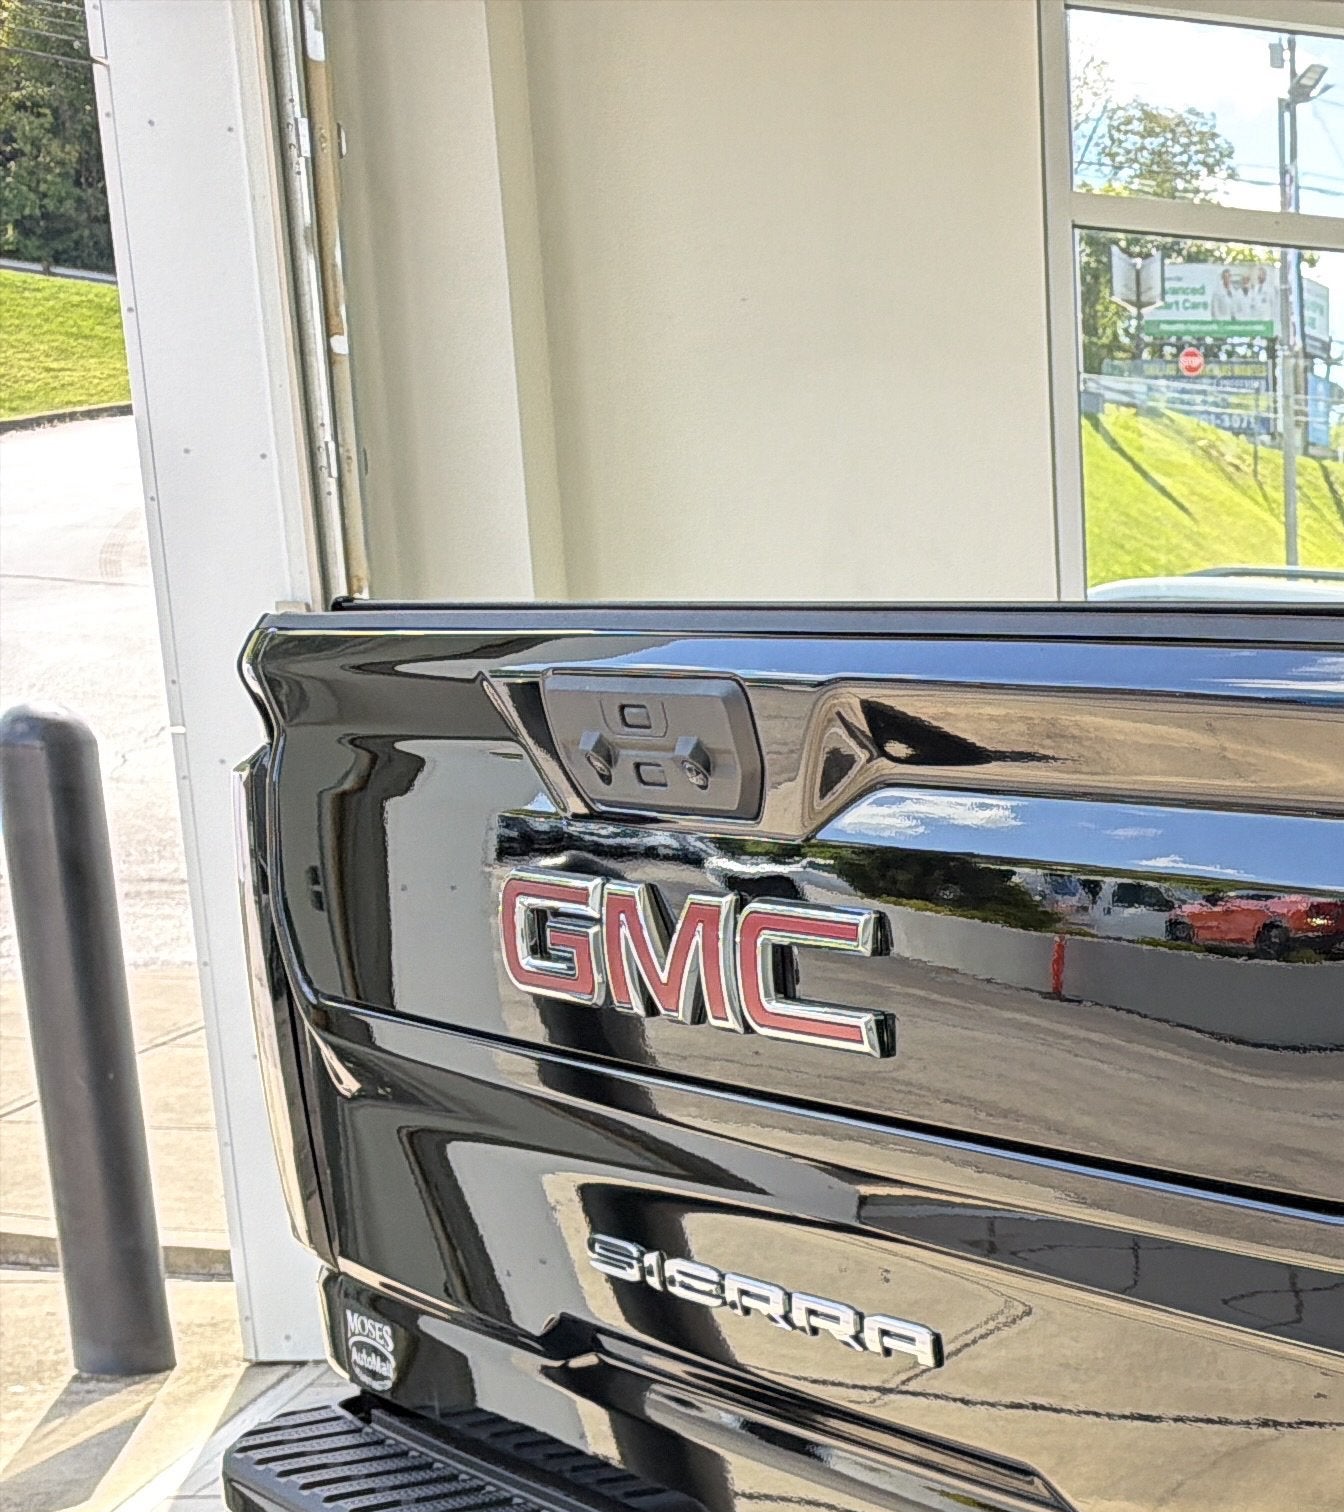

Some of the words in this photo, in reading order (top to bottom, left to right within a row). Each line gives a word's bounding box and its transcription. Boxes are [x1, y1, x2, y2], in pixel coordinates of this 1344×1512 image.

[500, 866, 897, 1059] GMC
[345, 1308, 395, 1353] MOSES
[586, 1232, 945, 1369] SIERRA
